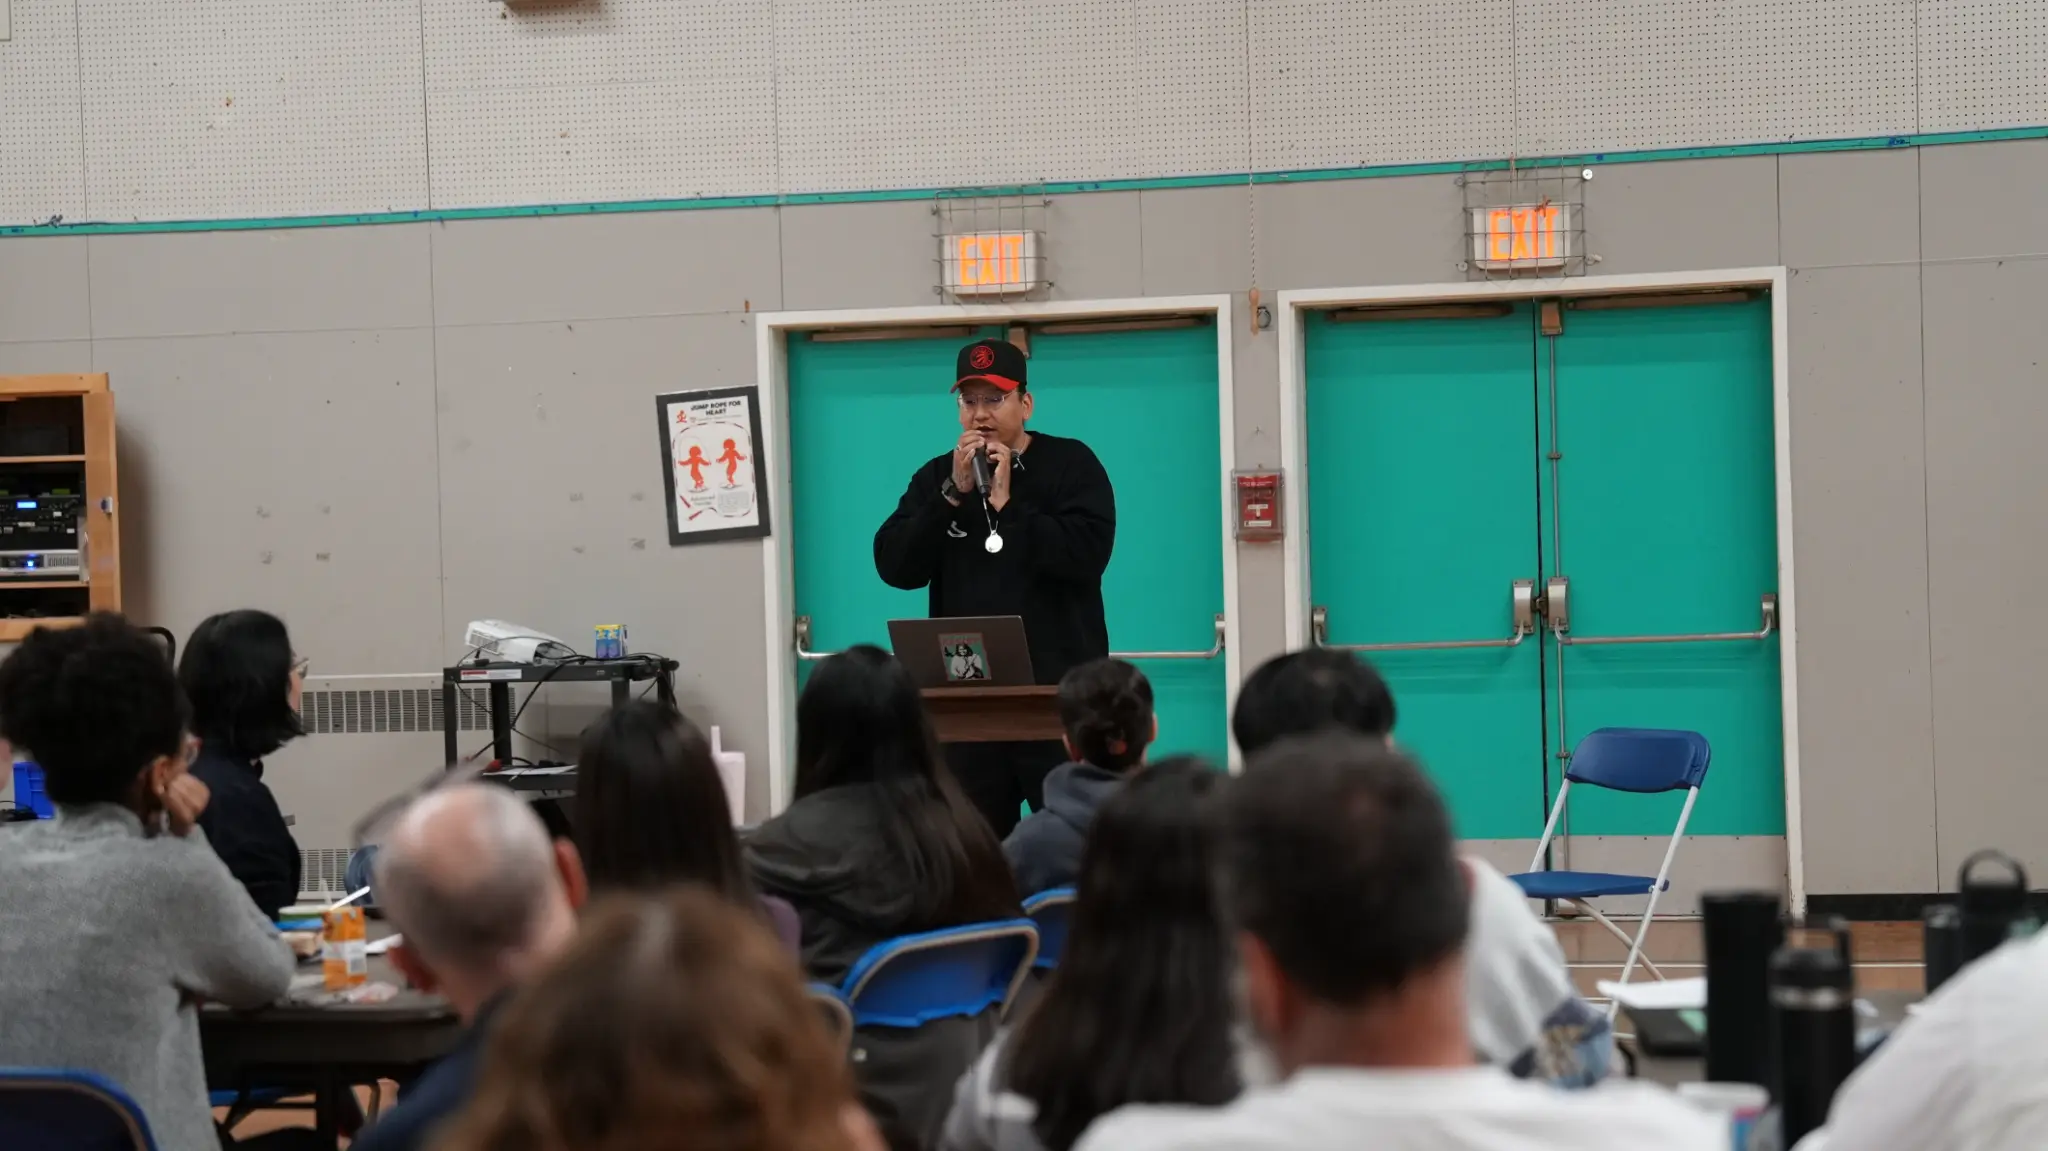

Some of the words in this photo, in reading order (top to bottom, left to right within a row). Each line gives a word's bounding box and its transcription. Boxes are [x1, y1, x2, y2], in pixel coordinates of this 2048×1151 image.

[1489, 207, 1559, 262] EXIT
[958, 235, 1024, 286] EXIT
[691, 403, 709, 411] JUMP
